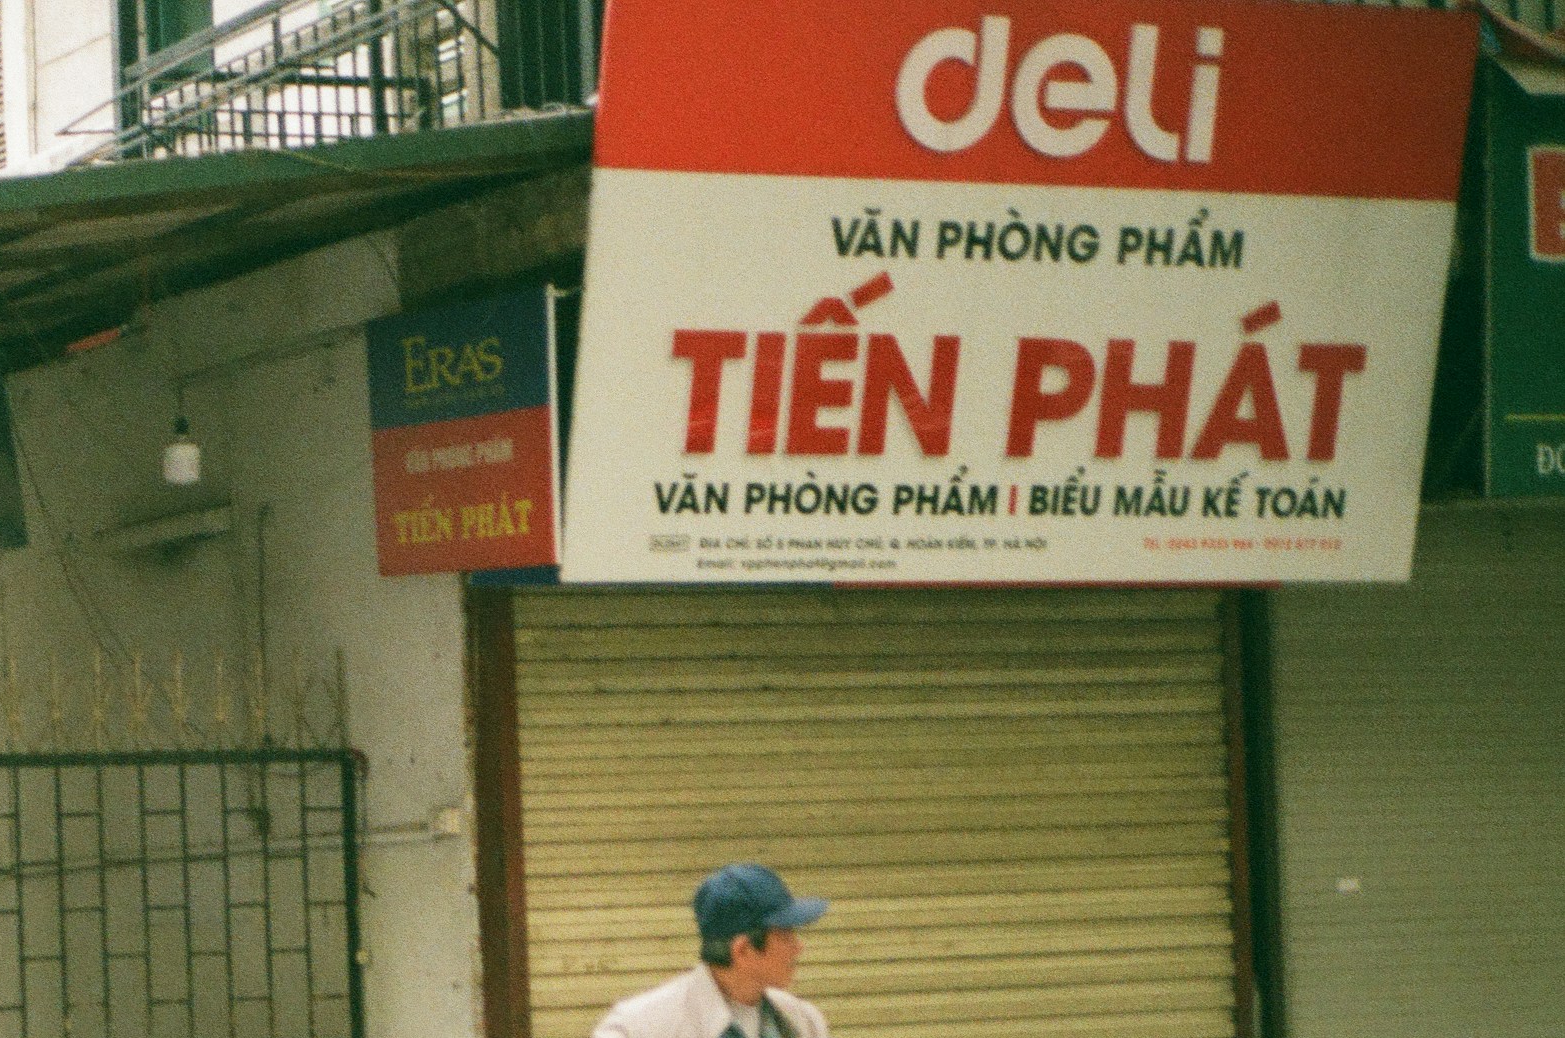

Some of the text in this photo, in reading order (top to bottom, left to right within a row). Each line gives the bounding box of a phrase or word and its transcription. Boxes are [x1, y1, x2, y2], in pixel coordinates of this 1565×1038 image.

[895, 14, 1224, 164] deli
[831, 206, 1246, 269] VĂN PHÒNG PHẨM
[671, 271, 1369, 462] TIẾN PHÁT
[458, 490, 533, 541] PHÁT
[654, 464, 1347, 519] VĂN PHÒNG PHẨM BIỂU MẪU KẾ TOÁN
